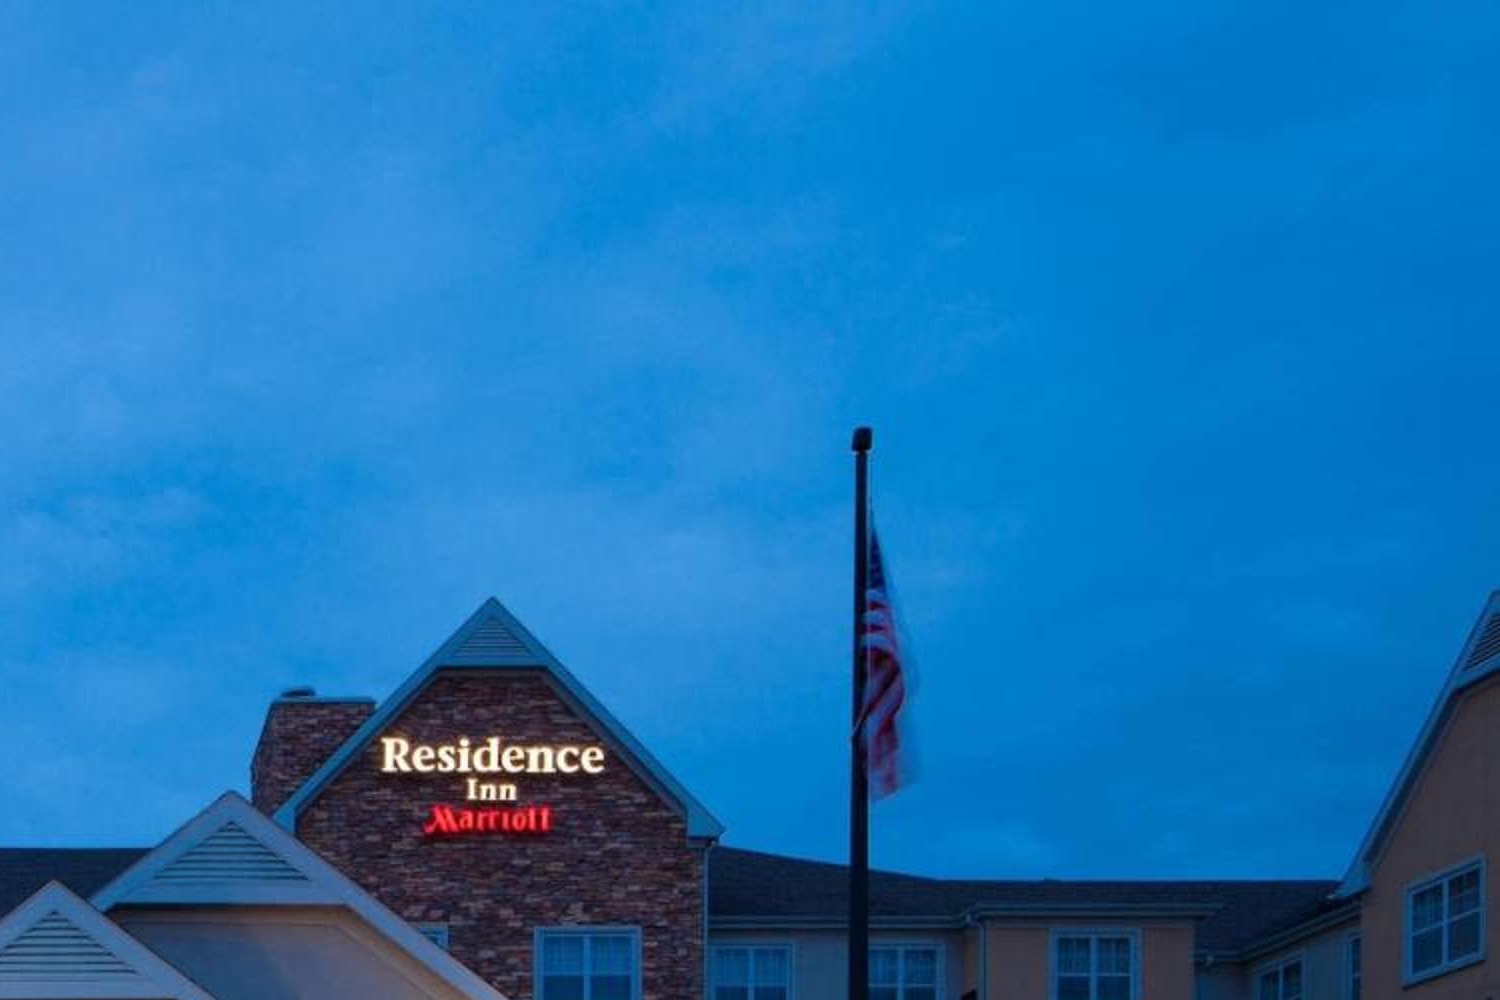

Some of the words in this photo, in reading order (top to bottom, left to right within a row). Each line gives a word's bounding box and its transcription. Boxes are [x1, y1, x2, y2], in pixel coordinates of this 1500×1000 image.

[381, 736, 606, 774] Residence
[466, 778, 517, 801] Inn
[424, 804, 551, 833] Marriott
